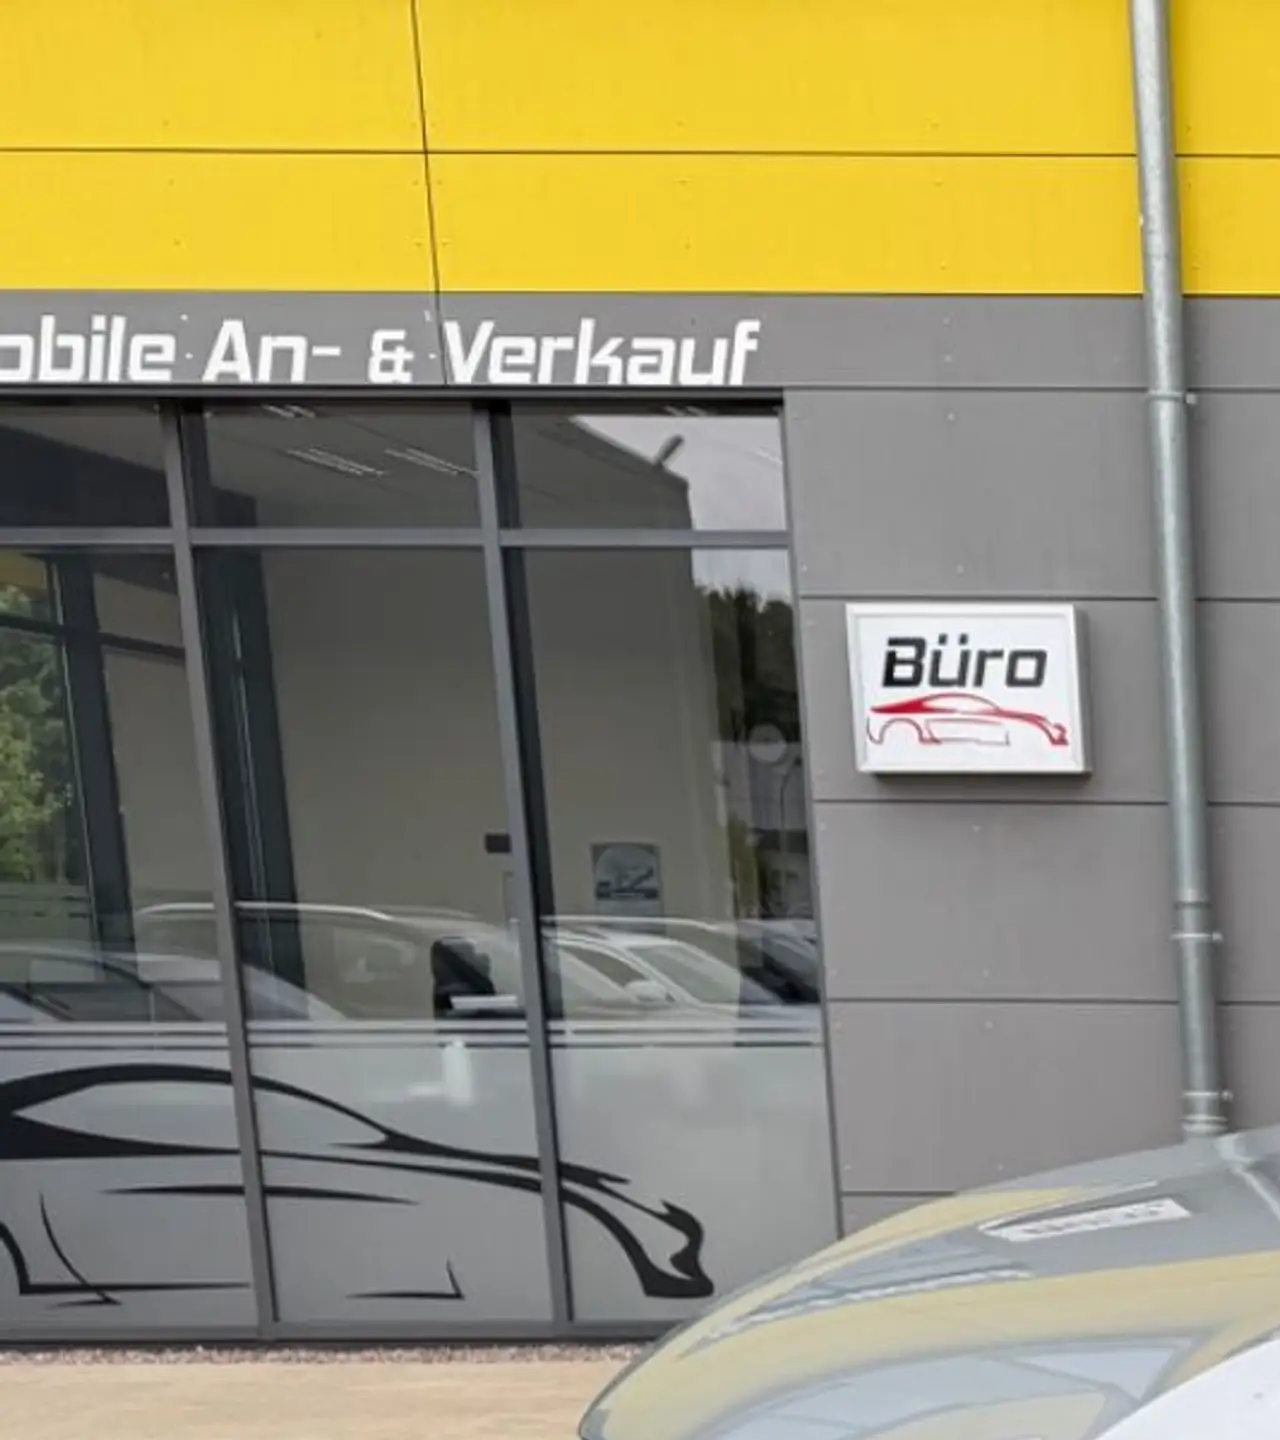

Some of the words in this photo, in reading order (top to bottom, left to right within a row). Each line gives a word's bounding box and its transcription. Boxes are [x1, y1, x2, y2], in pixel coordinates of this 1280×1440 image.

[0, 315, 176, 383] obile
[201, 319, 341, 384] An-
[367, 329, 415, 384] &
[443, 317, 761, 385] Verkauf
[881, 633, 1048, 688] Büro
